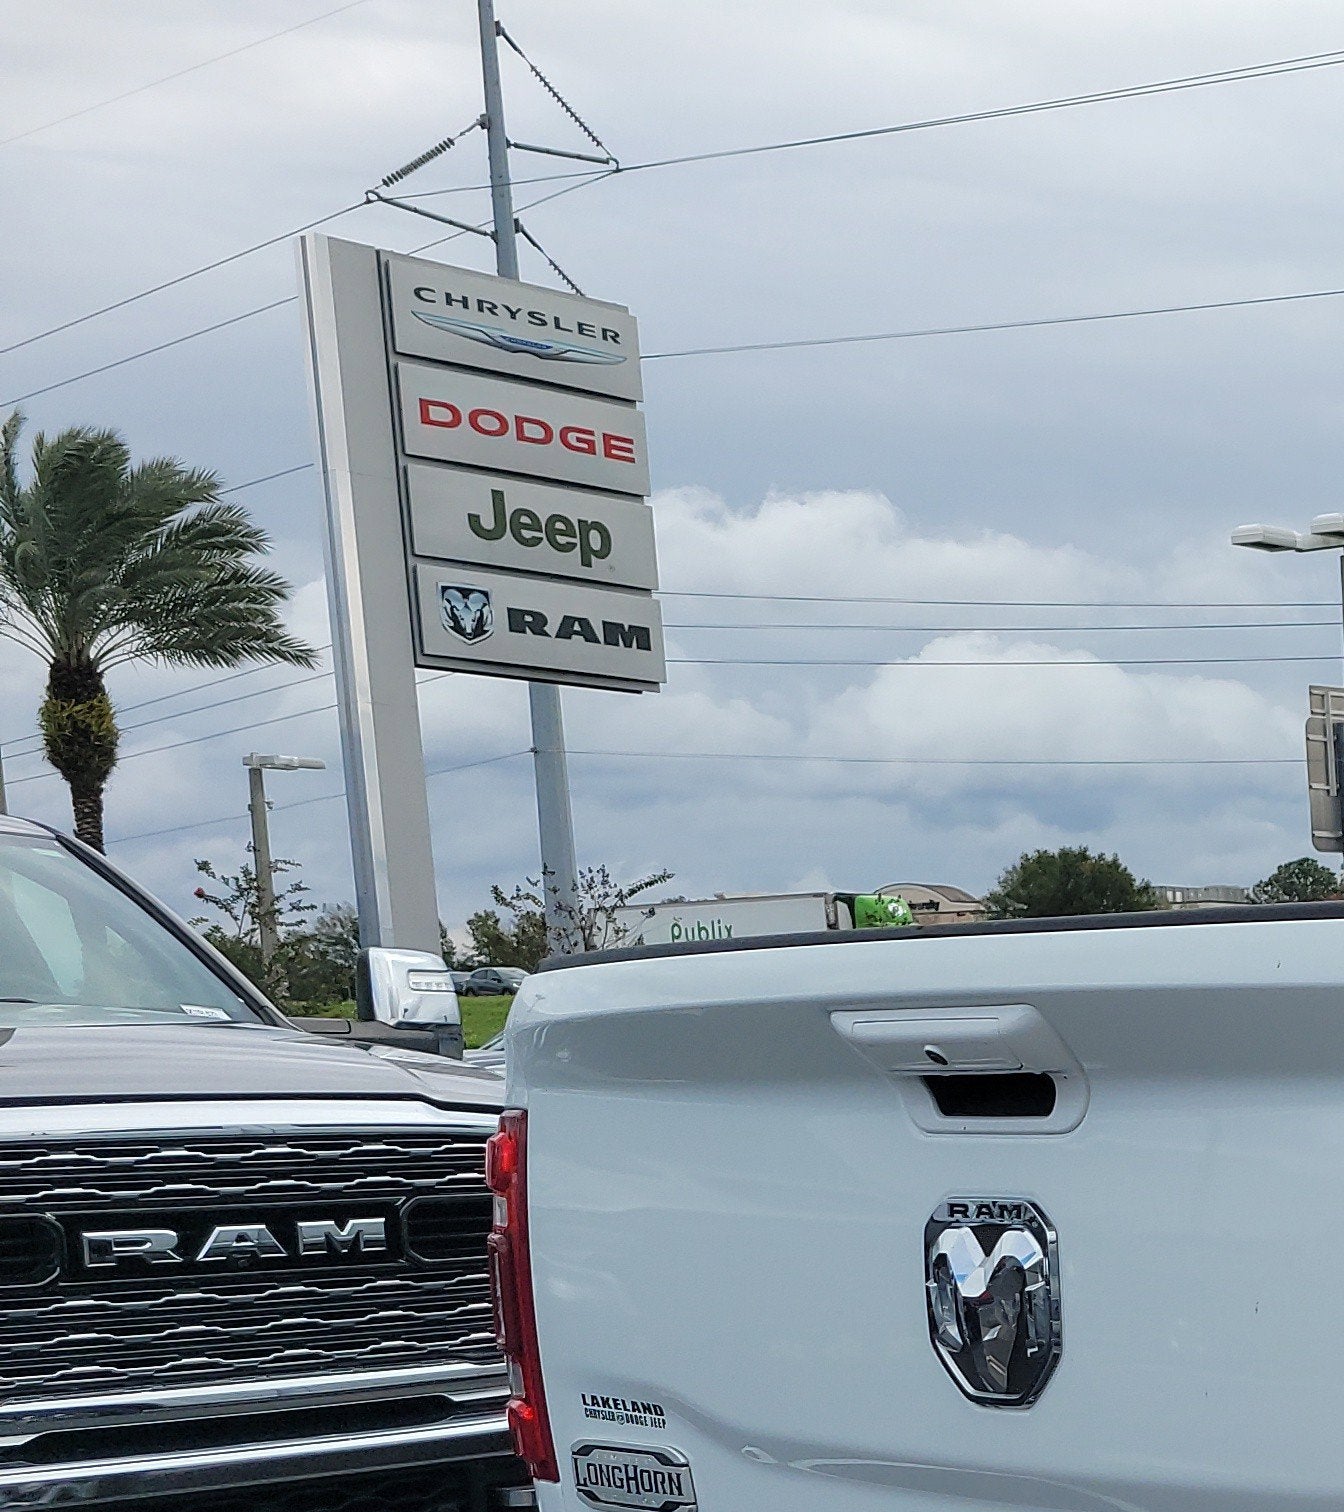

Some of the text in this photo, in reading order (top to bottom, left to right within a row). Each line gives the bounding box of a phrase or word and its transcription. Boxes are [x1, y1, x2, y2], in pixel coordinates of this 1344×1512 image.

[413, 286, 621, 345] CHRYSLER
[418, 397, 636, 463] DODGE
[467, 488, 613, 567] Jeep
[506, 606, 652, 652] RAM
[671, 919, 733, 943] Publix
[946, 1202, 1023, 1220] RAM
[81, 1217, 388, 1267] RAM
[581, 1393, 665, 1417] LAKELAND
[584, 1407, 667, 1429] CHRYSLER DODGE JEEP
